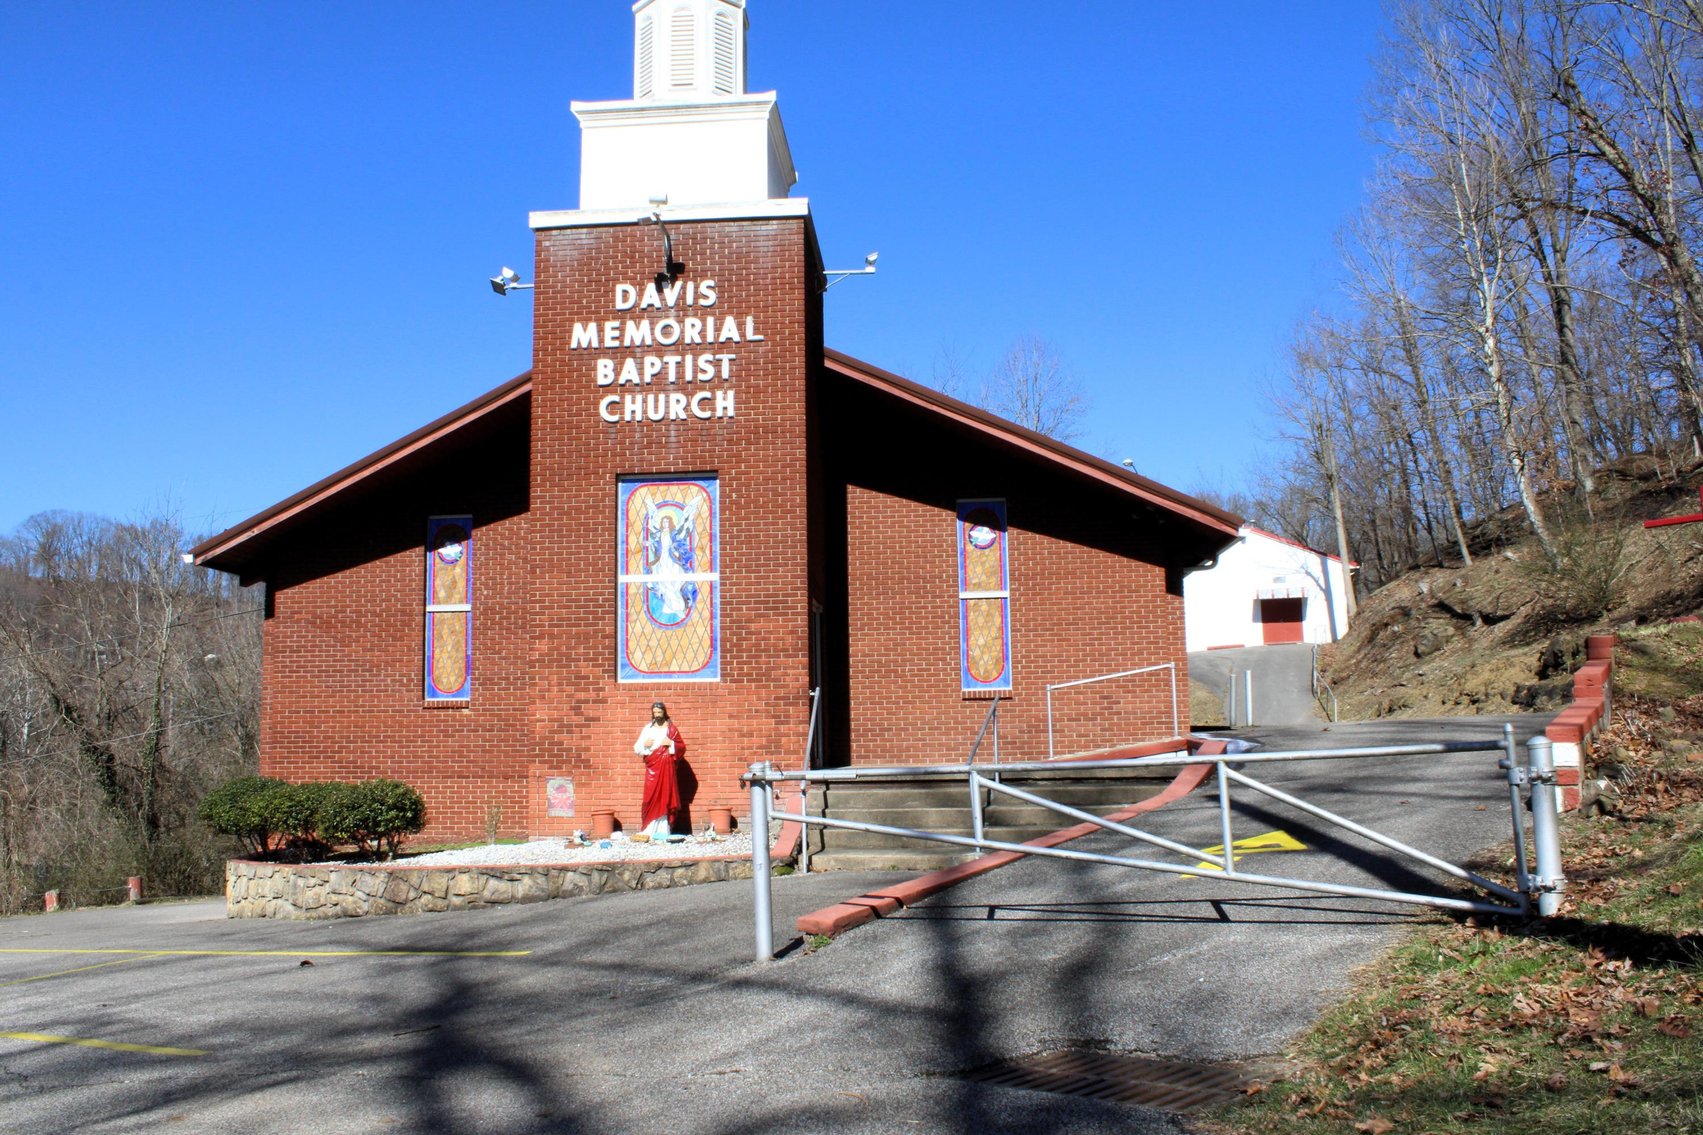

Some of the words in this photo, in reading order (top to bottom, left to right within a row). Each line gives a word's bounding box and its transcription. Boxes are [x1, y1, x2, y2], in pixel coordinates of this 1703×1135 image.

[615, 280, 717, 310] DAVIS
[570, 316, 764, 349] MEMORIAL
[597, 354, 736, 386] BAPTIST
[600, 390, 735, 422] CHURCH
